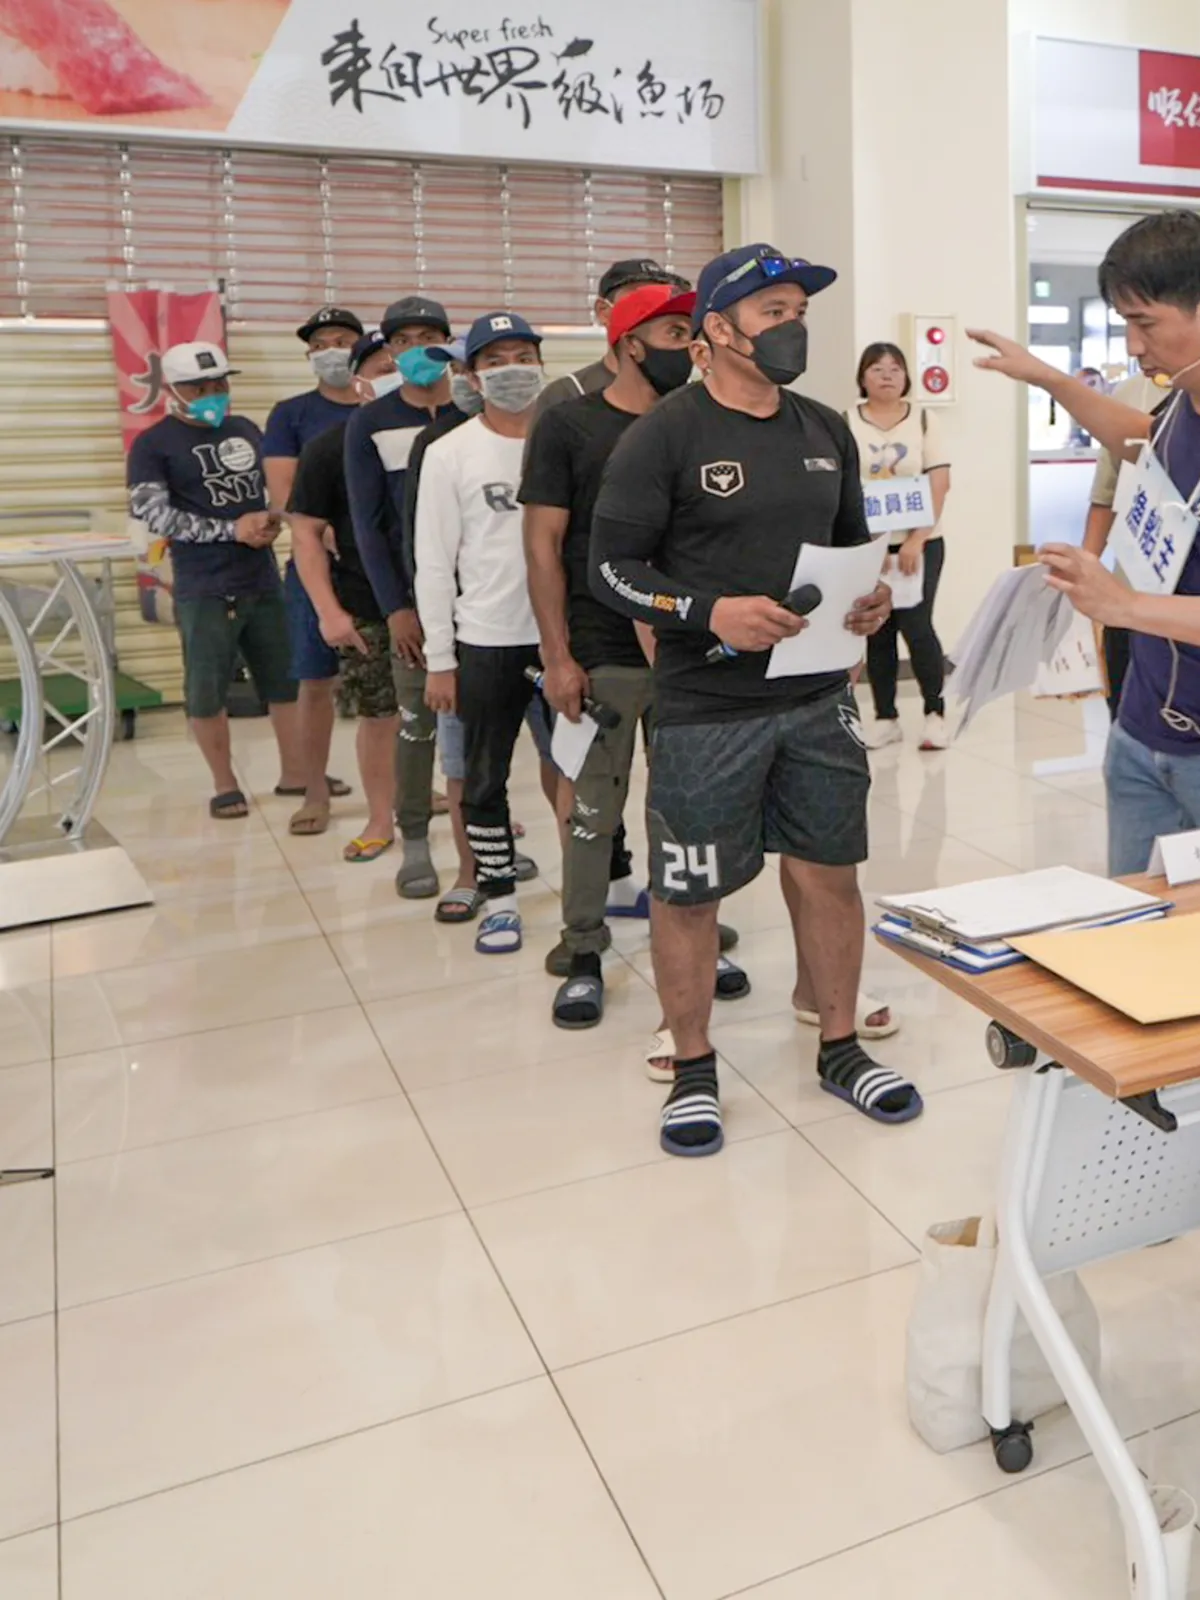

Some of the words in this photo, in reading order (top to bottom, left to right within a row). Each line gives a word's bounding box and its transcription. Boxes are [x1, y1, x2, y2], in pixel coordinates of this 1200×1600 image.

[427, 17, 493, 51] Super
[500, 15, 554, 43] fresh
[192, 444, 225, 478] I
[203, 470, 260, 506] NY
[661, 841, 719, 891] 24
